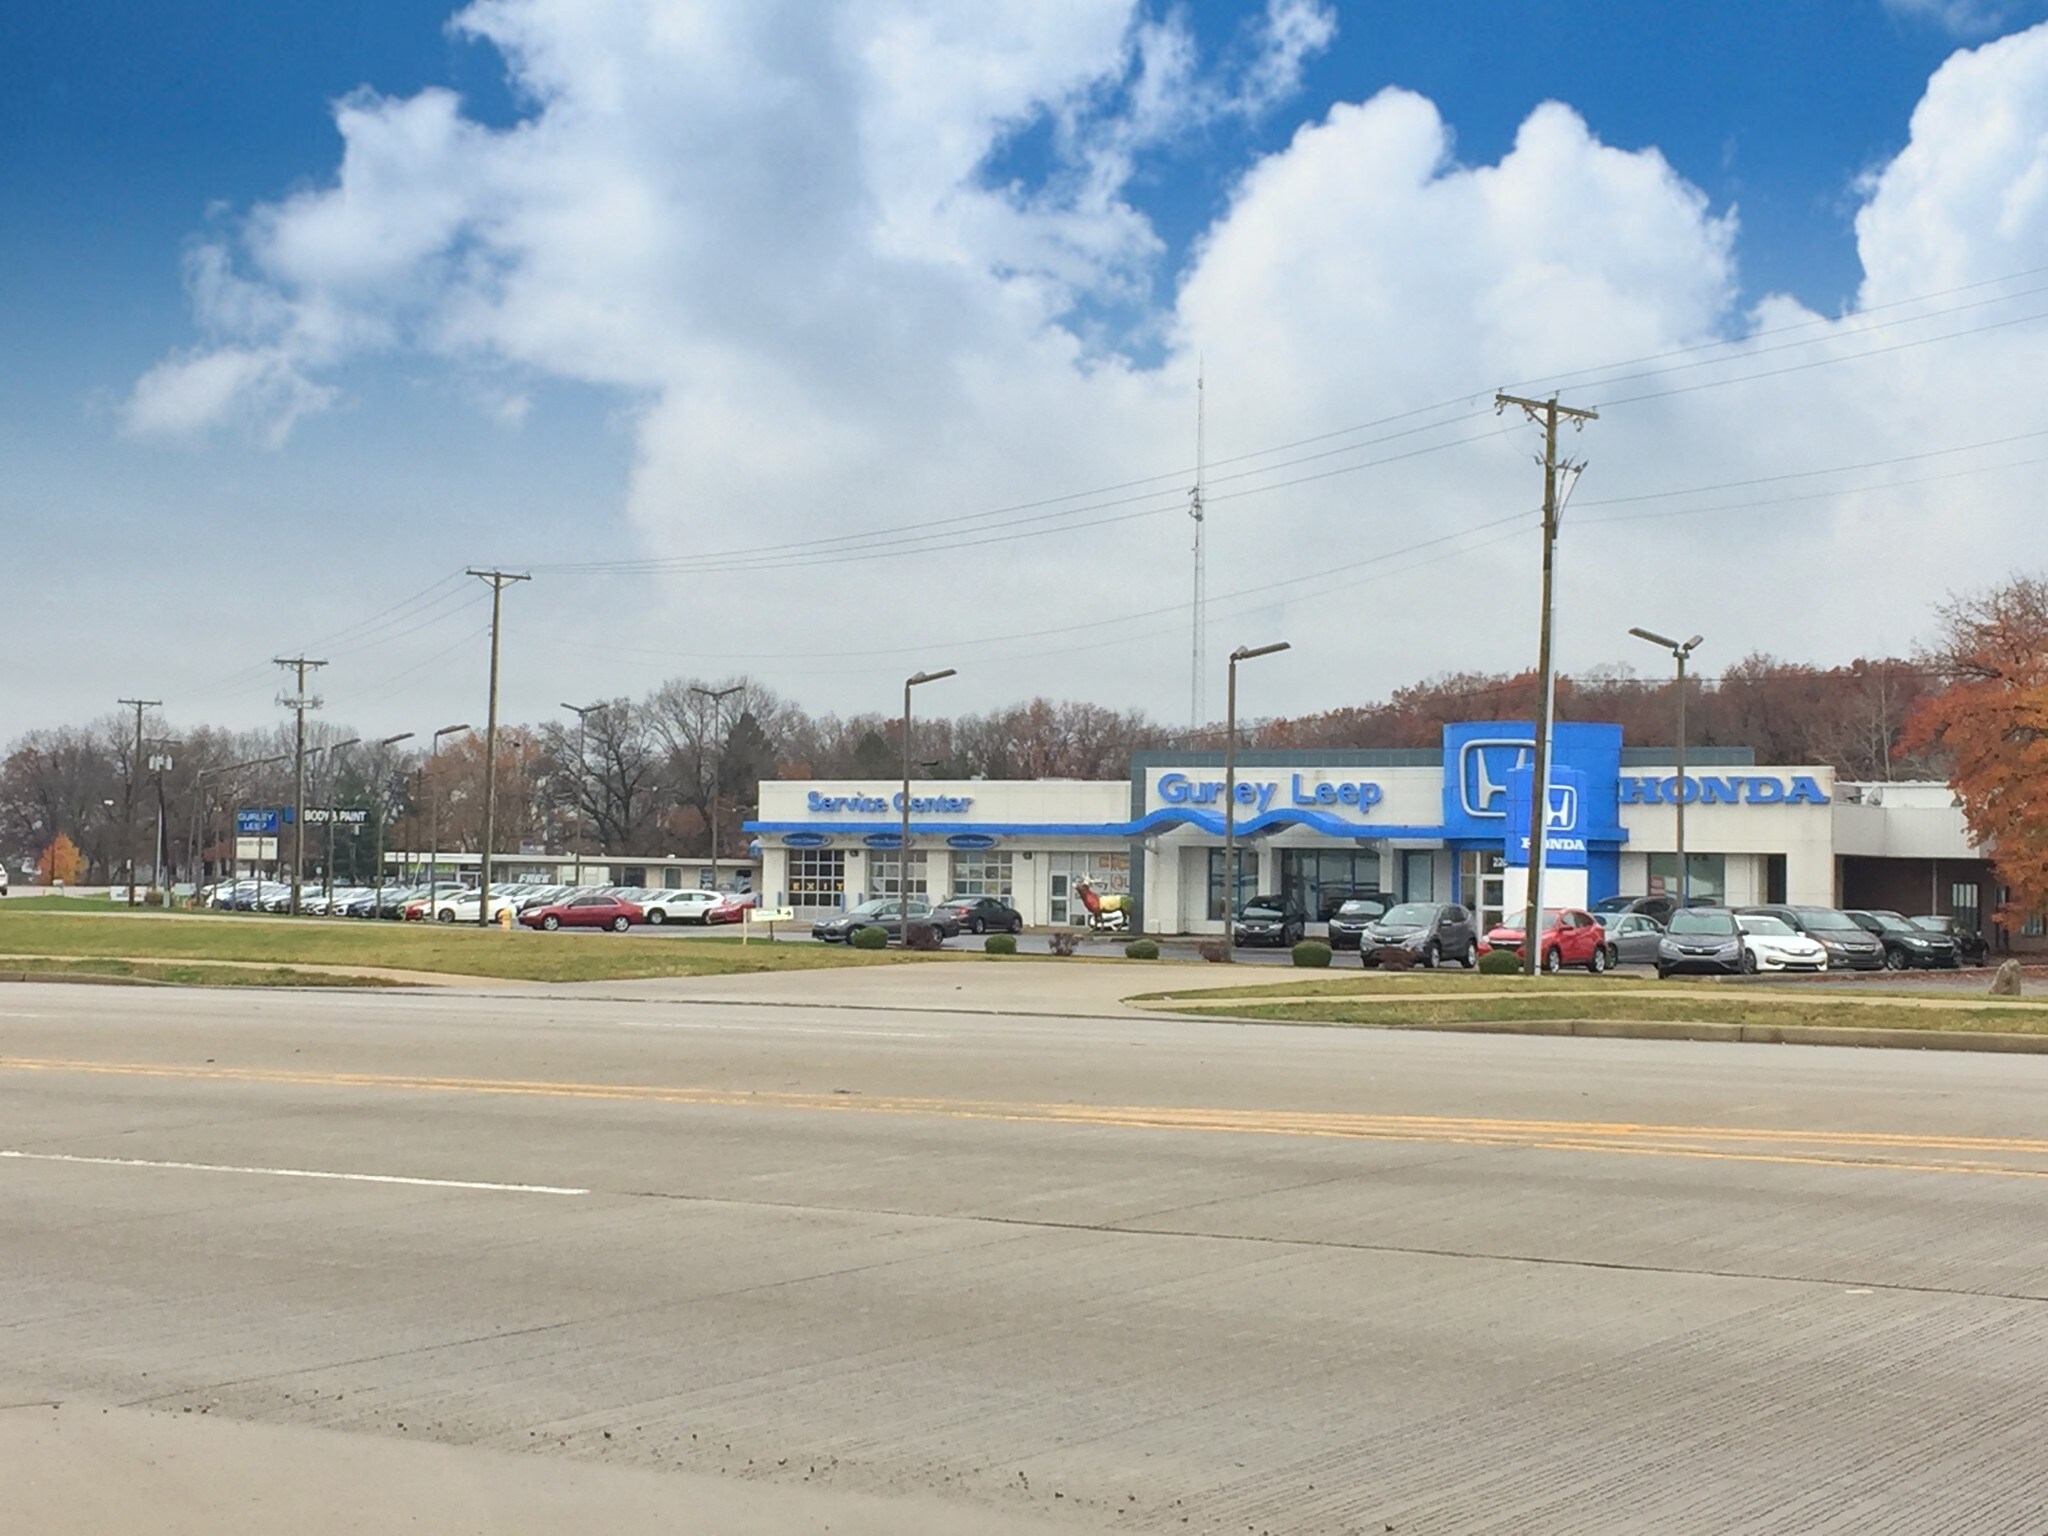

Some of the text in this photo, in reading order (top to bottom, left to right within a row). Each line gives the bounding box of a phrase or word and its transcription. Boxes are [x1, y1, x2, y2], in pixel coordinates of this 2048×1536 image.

[1157, 773, 1384, 814] Gurey Leep
[1618, 775, 1831, 804] HONDA
[807, 790, 974, 813] Service Center
[304, 809, 330, 821] BODY
[339, 811, 367, 822] PAINT
[518, 873, 552, 883] FREE
